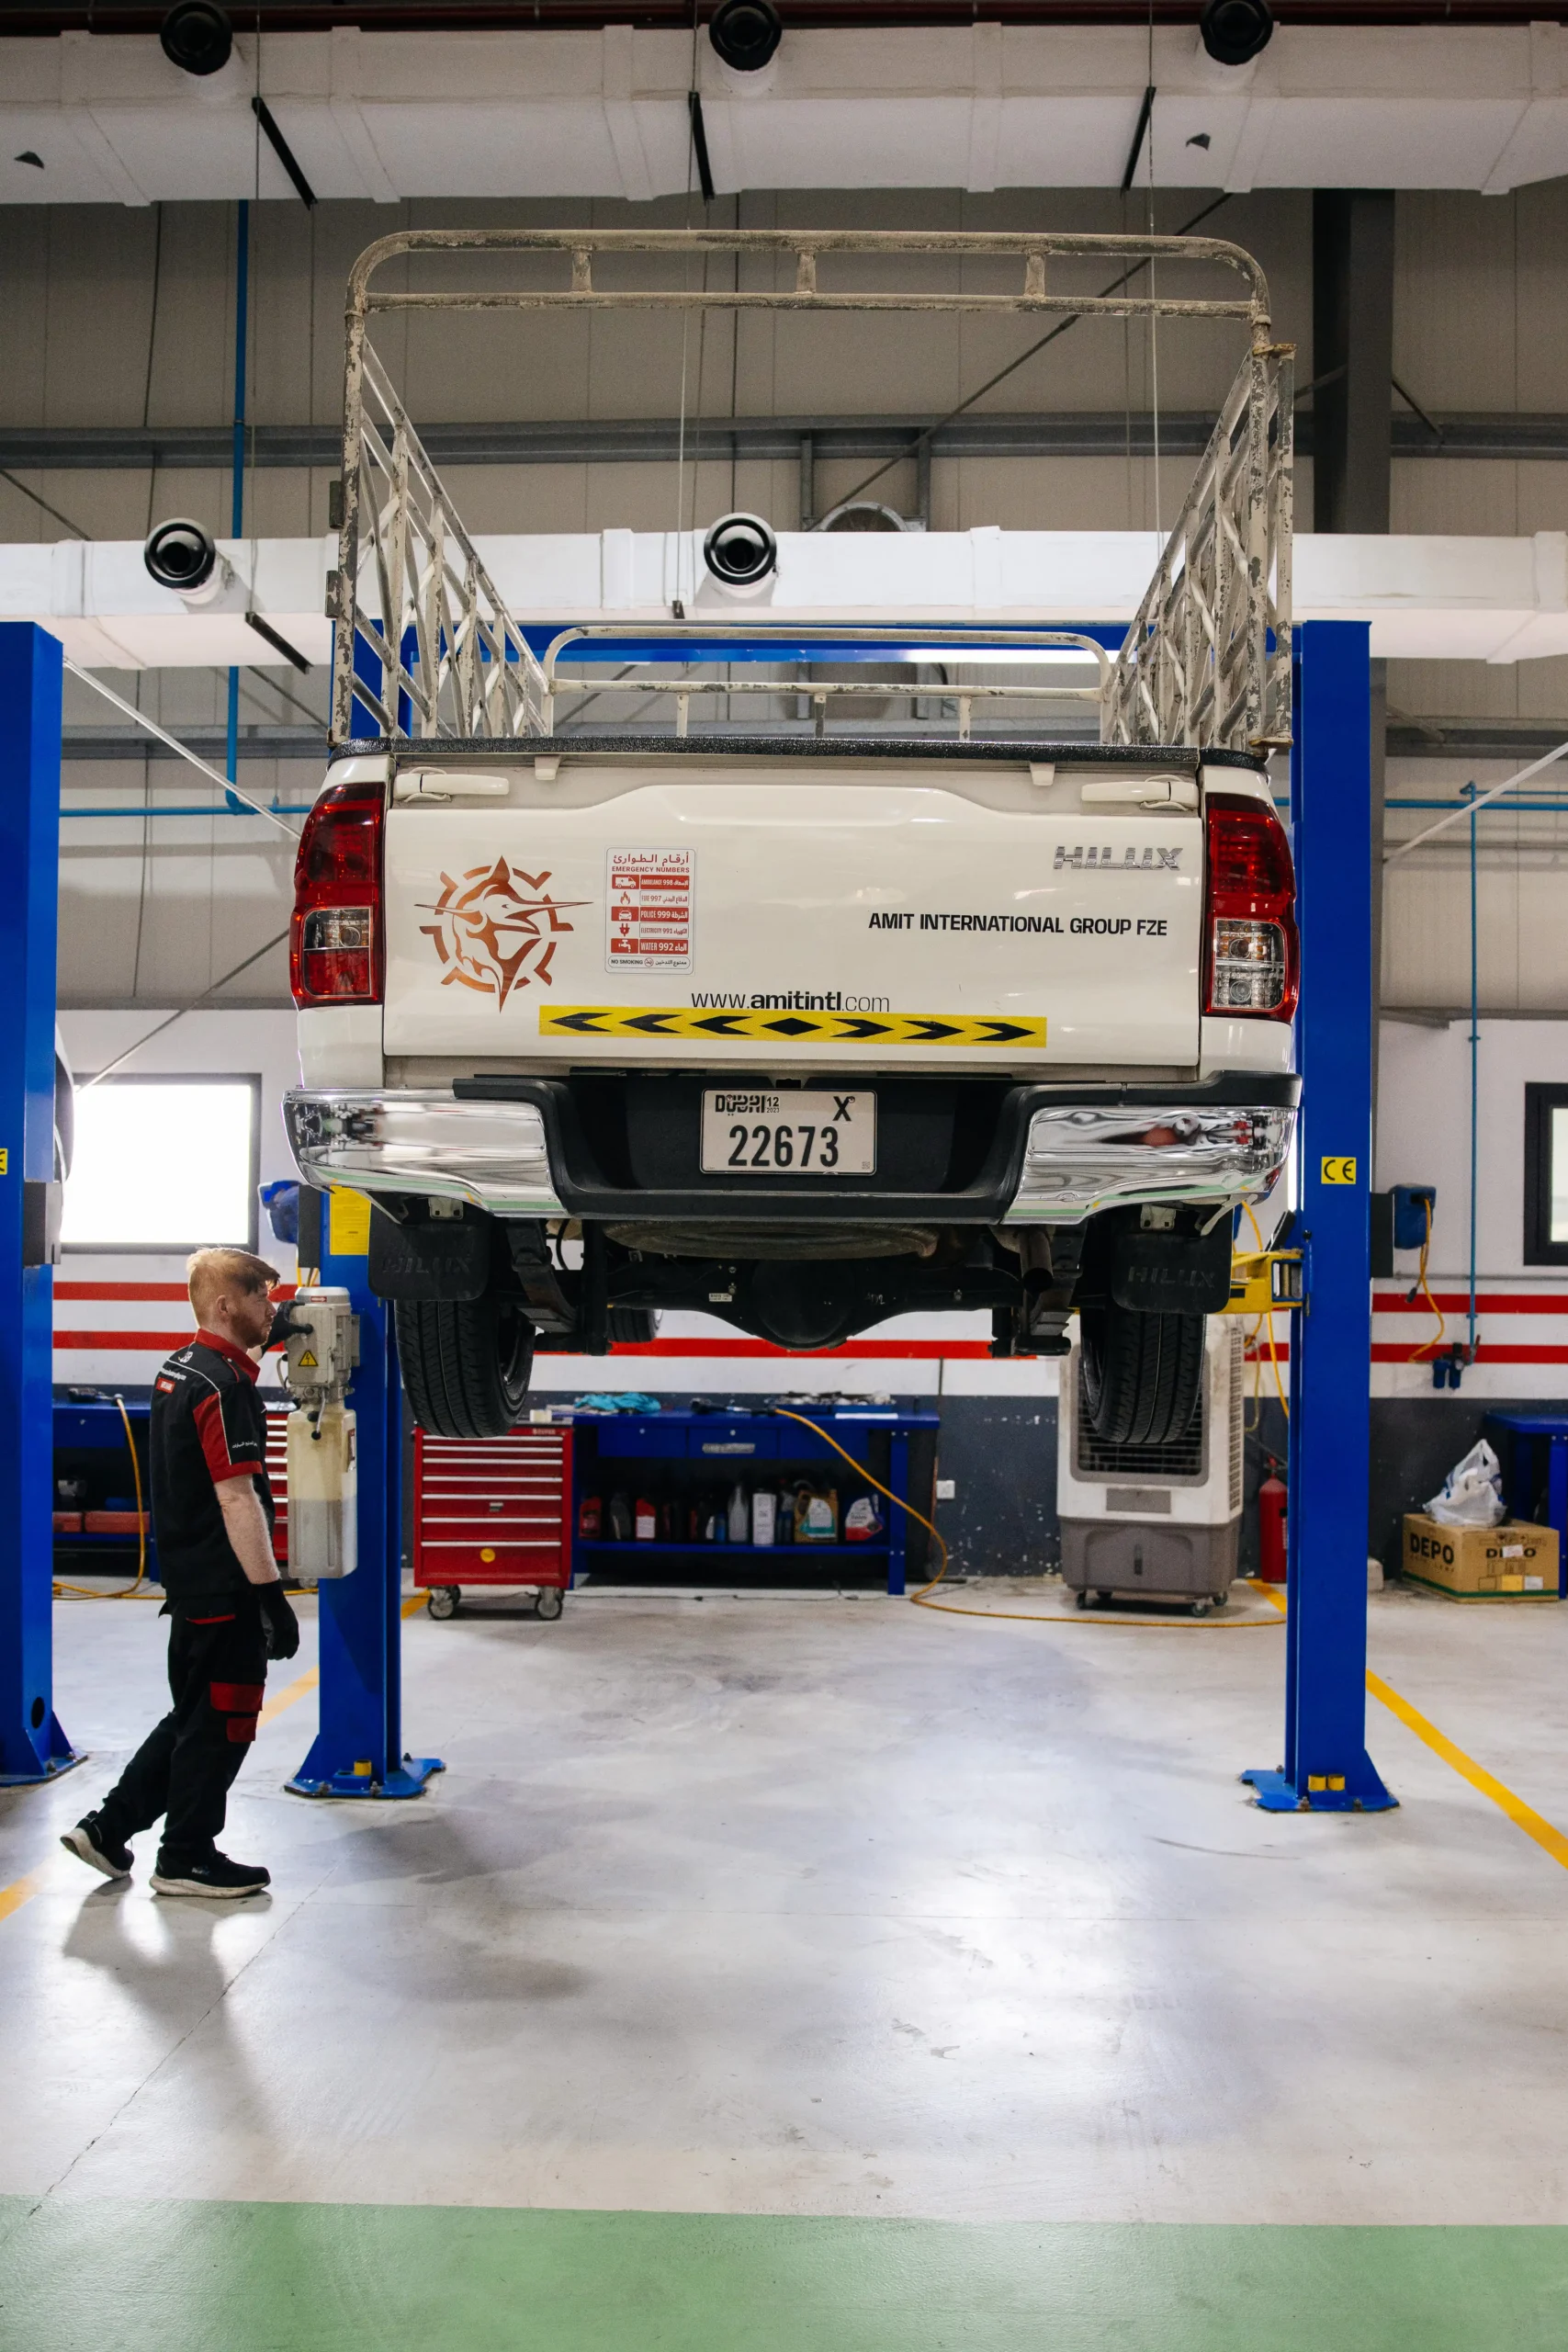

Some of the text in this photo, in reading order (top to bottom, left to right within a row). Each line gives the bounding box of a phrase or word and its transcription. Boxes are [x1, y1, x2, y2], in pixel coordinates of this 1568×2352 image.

[613, 851, 689, 866] أرقام الطوارئ
[1053, 846, 1183, 871] HILUX
[641, 910, 671, 919] POLICE 999
[671, 910, 688, 920] الشرطة
[868, 912, 1168, 936] AMIT INTERNATIONAL GROUP FZE
[641, 943, 673, 952] WATER 992
[674, 944, 687, 952] الماء
[691, 990, 890, 1012] www.amitintl.com
[766, 1096, 780, 1107] 12
[832, 1095, 852, 1122] X
[728, 1125, 839, 1168] 22673
[1324, 1159, 1354, 1182] CE
[1409, 1532, 1454, 1565] DEPO
